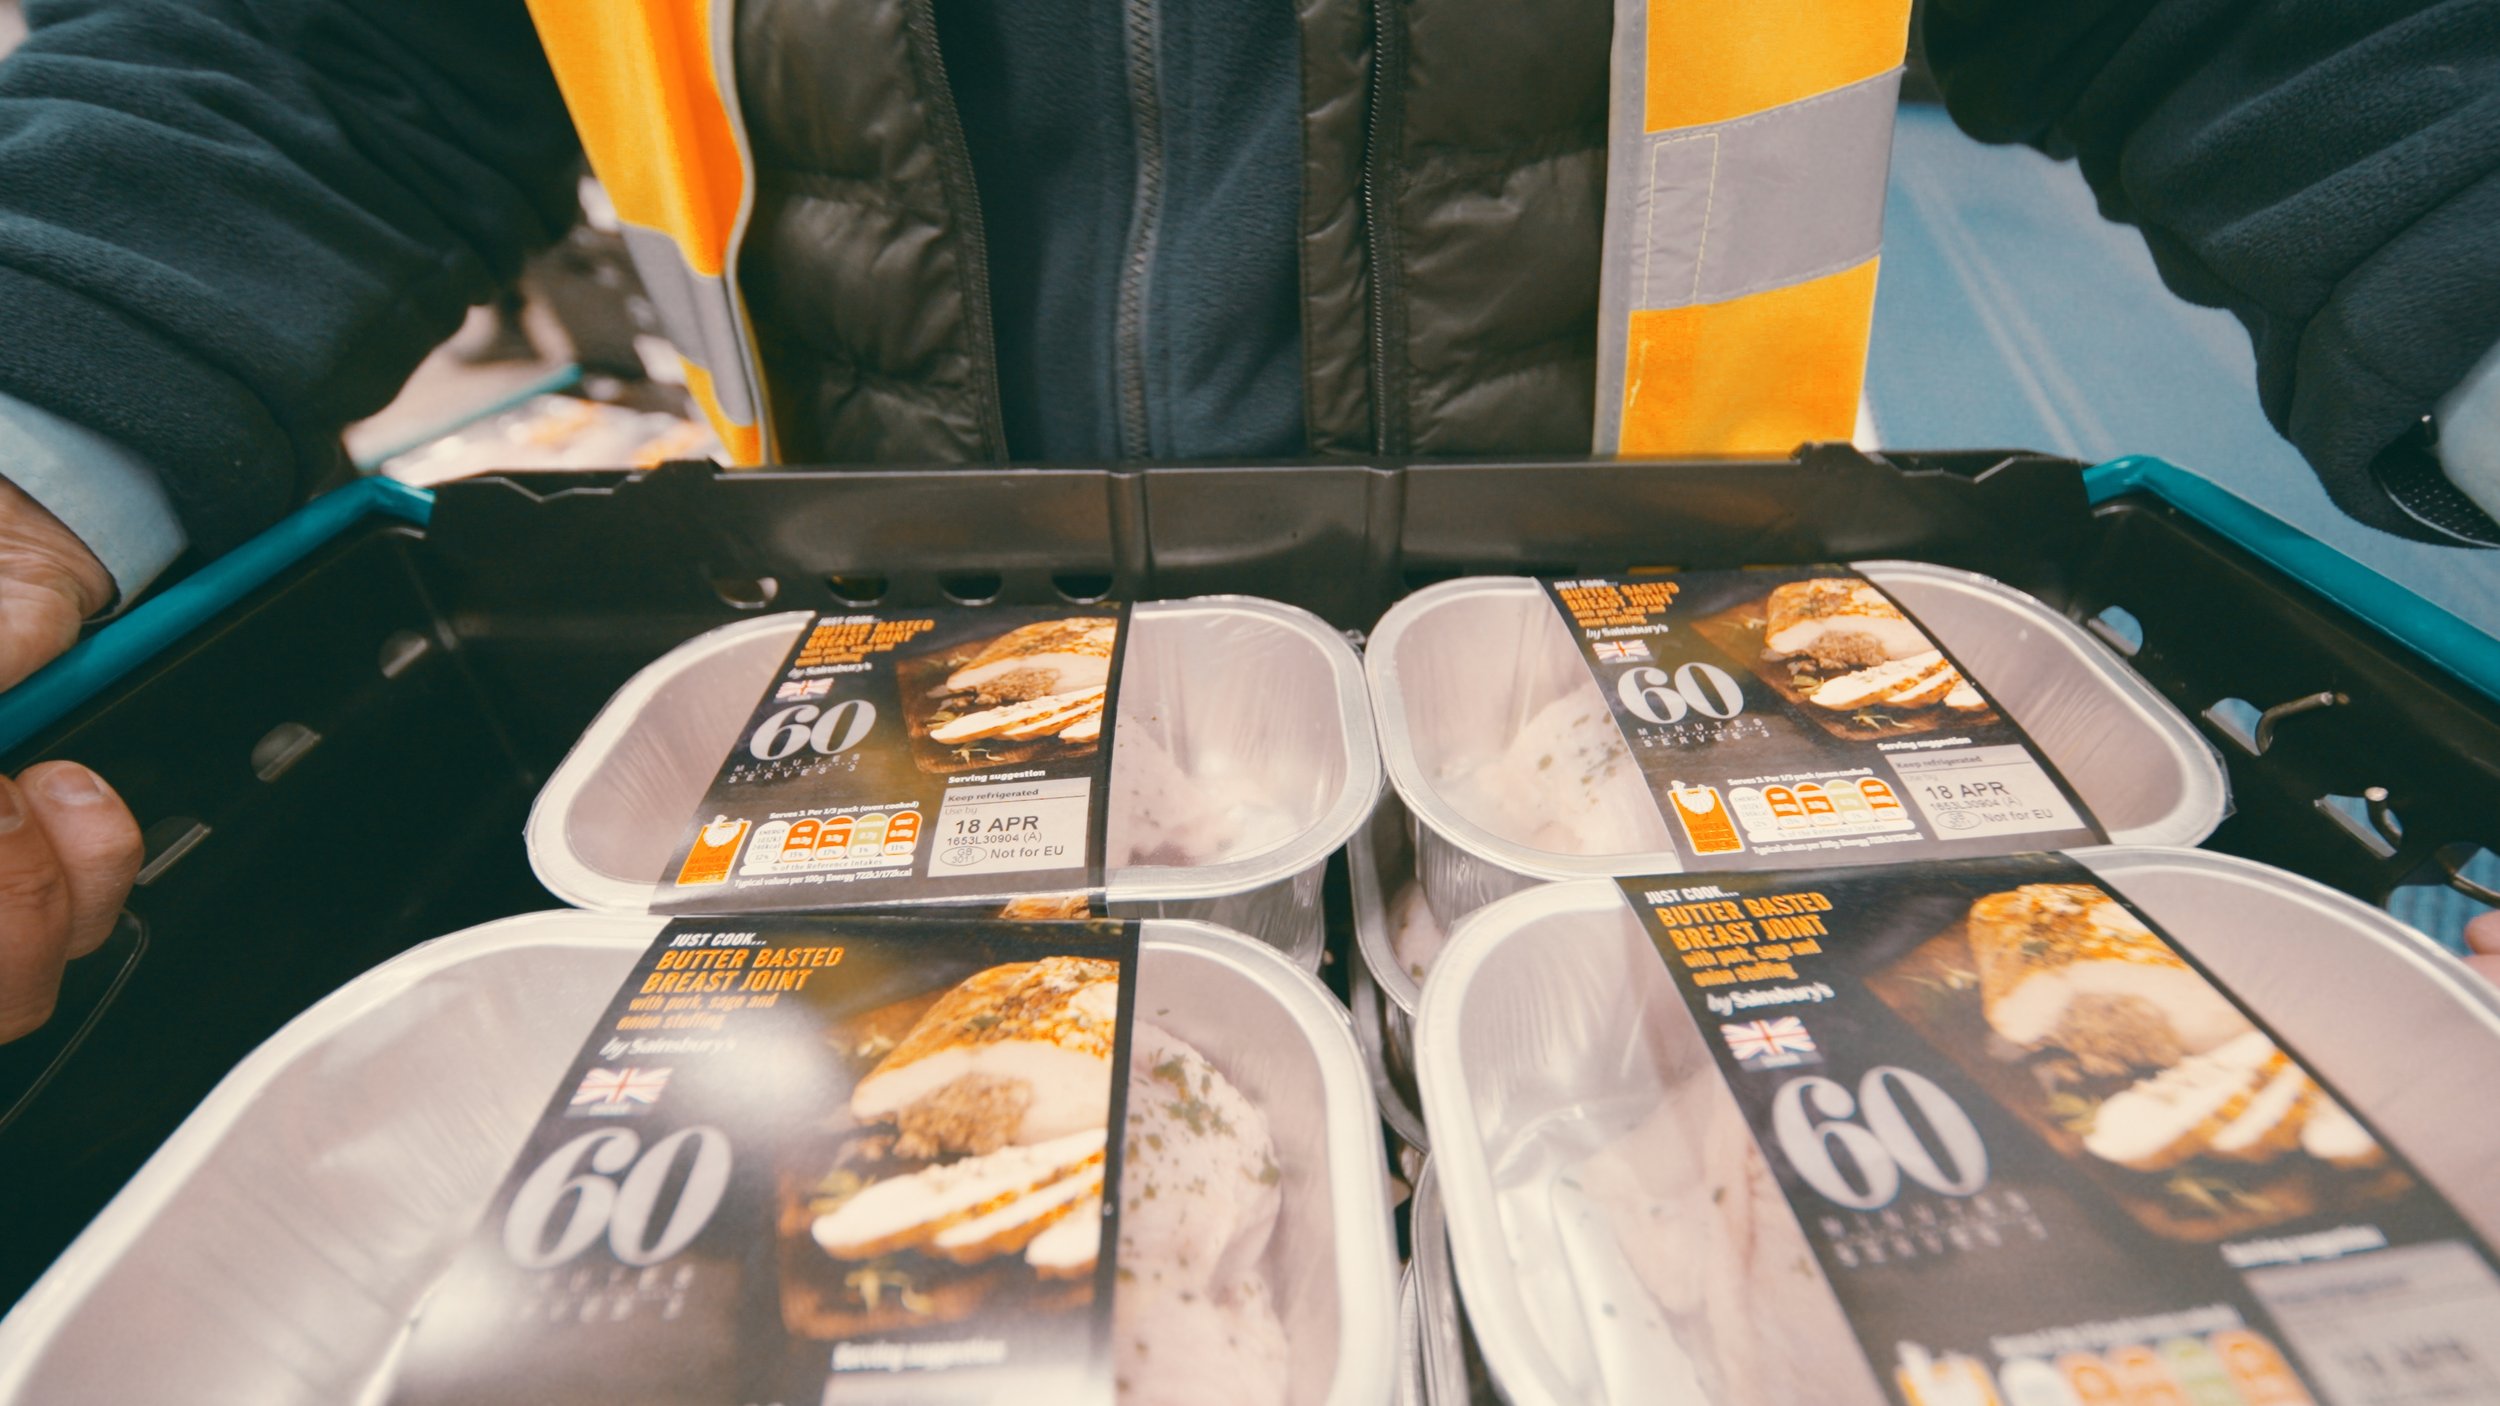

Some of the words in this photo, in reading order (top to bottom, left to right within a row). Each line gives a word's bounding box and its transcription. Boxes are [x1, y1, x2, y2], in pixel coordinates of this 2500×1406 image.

[1586, 629, 1600, 640] by
[1602, 624, 1668, 636] Sainsbury's
[1618, 662, 1744, 724] 60
[750, 700, 876, 760] 60
[1637, 718, 1762, 736] MINUTES
[1644, 732, 1741, 748] SERVES
[1761, 730, 1770, 738] 3
[734, 753, 860, 772] MINUTES
[728, 767, 827, 784] SERVES
[848, 764, 857, 772] 3
[948, 774, 988, 784] Serving
[989, 770, 1046, 780] suggestion
[948, 795, 974, 803] Keep
[976, 789, 1039, 801] refrigerated
[1926, 785, 1952, 800] 18
[1960, 782, 2010, 798] APR
[769, 811, 798, 819] Serves
[837, 806, 858, 814] pack
[860, 804, 884, 812] (oven
[884, 801, 920, 810] cooked)
[965, 807, 978, 815] by
[1983, 813, 2007, 822] Not
[2009, 811, 2030, 820] for
[2032, 809, 2053, 818] EU
[955, 819, 981, 834] 18
[988, 816, 1038, 832] APR
[947, 834, 1019, 846] 1653L30904
[1024, 832, 1042, 843] (A)
[957, 848, 973, 856] GB
[990, 849, 1014, 859] Not
[1019, 848, 1040, 857] for
[1043, 845, 1064, 856] EU
[734, 878, 764, 889] Typical
[764, 876, 789, 886] values
[790, 876, 804, 886] per
[826, 873, 854, 882] Energy
[1644, 890, 1681, 904] JUST
[1656, 900, 1745, 927] BUTTER
[1742, 892, 1833, 918] BASTED
[668, 933, 712, 948] JUST
[1668, 920, 1760, 950] BREAST
[1759, 914, 1828, 940] JOINT
[655, 949, 750, 970] BUTTER
[752, 947, 845, 969] BASTED
[640, 971, 740, 994] BREAST
[738, 969, 813, 992] JOINT
[628, 995, 666, 1011] with
[708, 995, 747, 1011] sage
[746, 992, 779, 1008] and
[1706, 993, 1733, 1016] by
[616, 1014, 662, 1031] onion
[662, 1012, 727, 1031] stuffing
[598, 1036, 631, 1060] by
[1772, 1065, 1989, 1211] 60
[503, 1124, 733, 1270] 60
